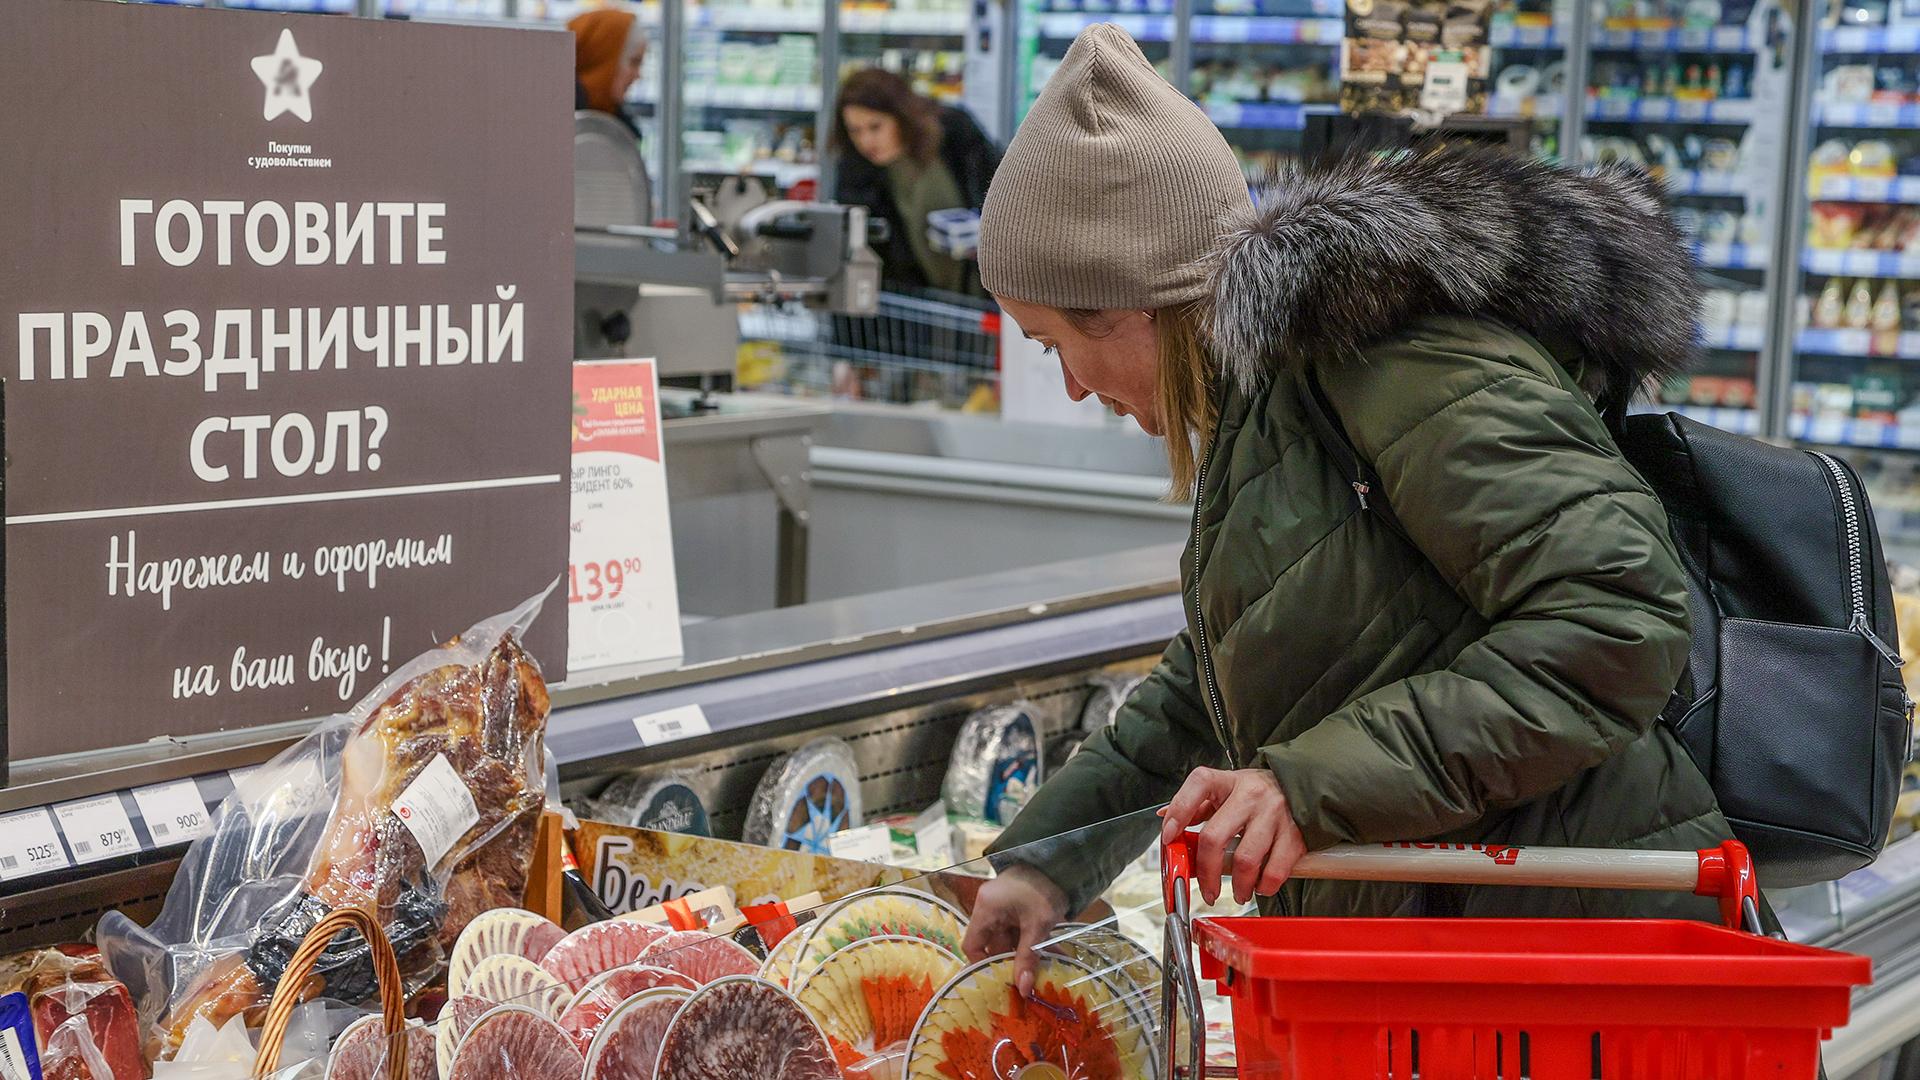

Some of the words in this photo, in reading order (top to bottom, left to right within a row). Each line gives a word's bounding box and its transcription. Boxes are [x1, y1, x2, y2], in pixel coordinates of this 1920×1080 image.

[268, 141, 312, 156] Покупки
[247, 156, 254, 166] с
[255, 155, 332, 170] удовольствием
[119, 199, 447, 267] ГОТОВИТЕ
[18, 284, 524, 392] ПРАЗДНИЧНЫЙ
[592, 385, 643, 404] УДАРНАЯ
[614, 401, 645, 418] ЦЕНА
[189, 405, 389, 483] СТОЛ?
[105, 530, 270, 611] Нарежем
[282, 552, 306, 579] и
[314, 534, 452, 593] оформим
[172, 664, 220, 699] на
[230, 646, 295, 692] ваш
[176, 813, 199, 830] 900
[99, 831, 122, 848] 879
[26, 846, 52, 862] 5125
